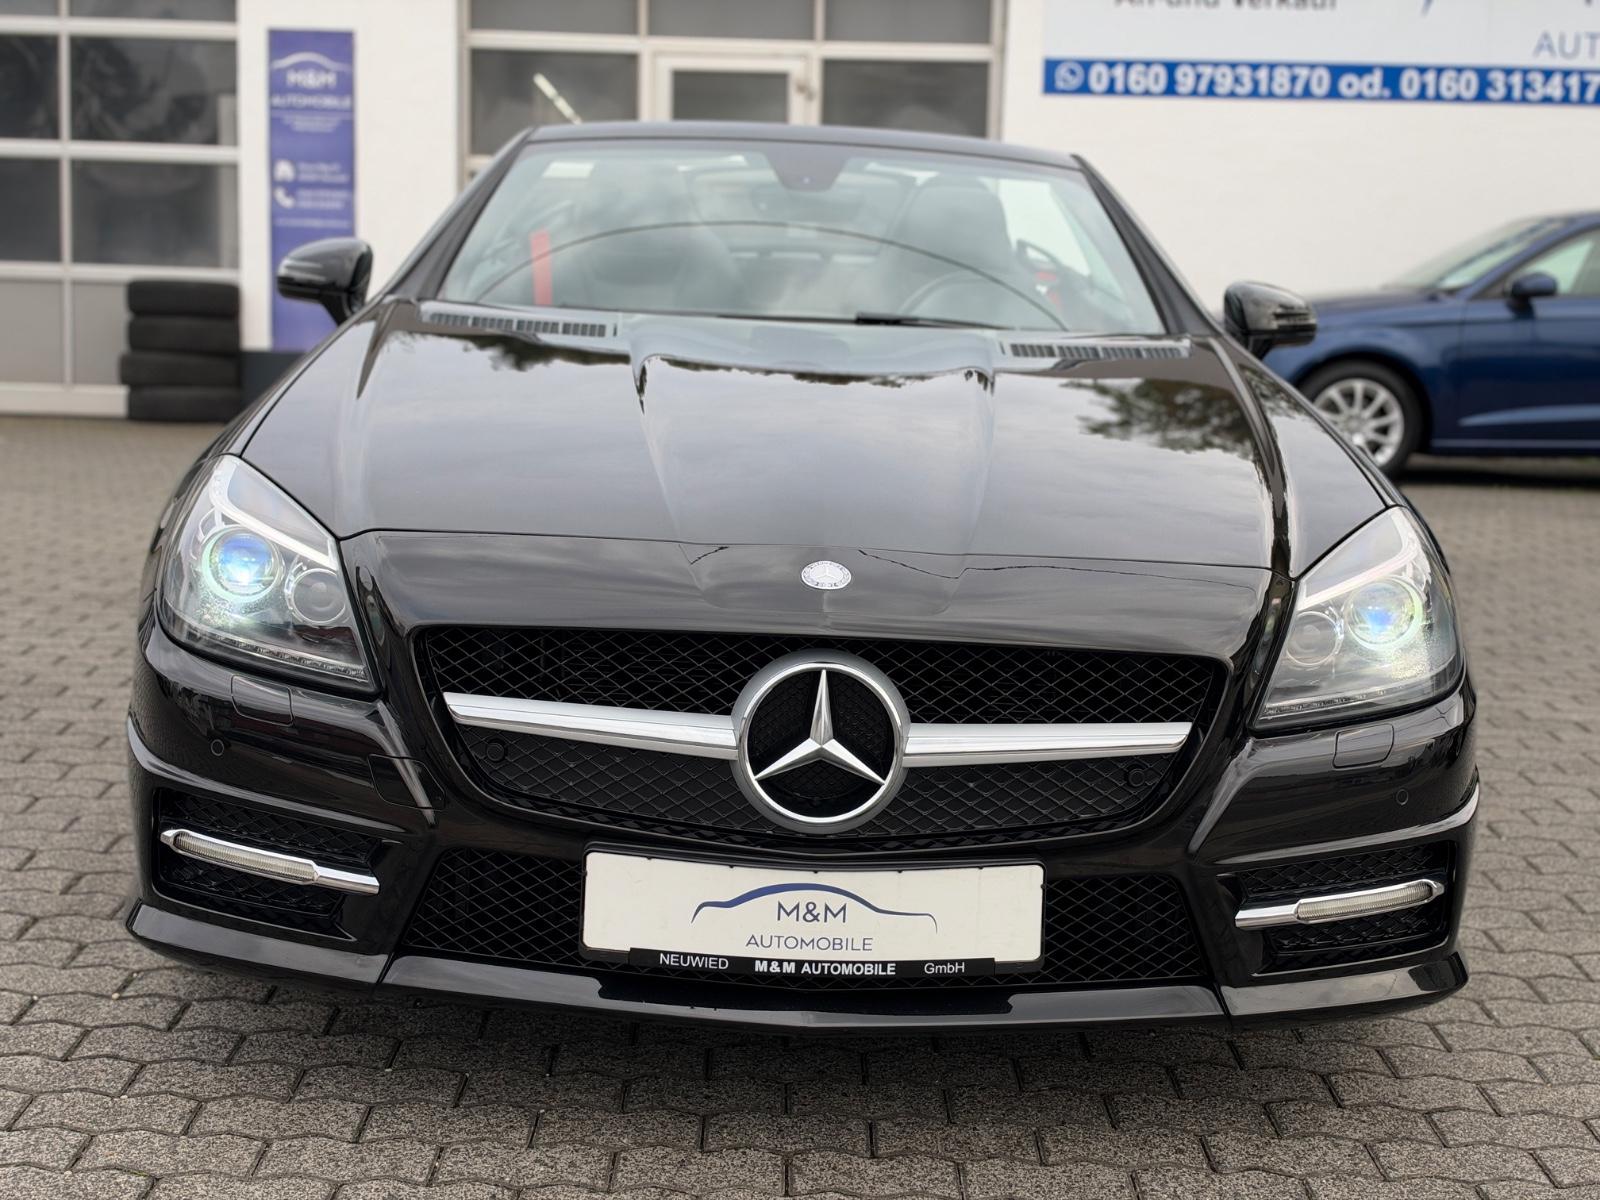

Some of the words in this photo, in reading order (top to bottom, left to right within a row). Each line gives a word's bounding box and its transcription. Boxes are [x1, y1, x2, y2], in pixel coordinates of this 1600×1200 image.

[1088, 62, 1168, 95] 0160
[1174, 64, 1331, 97] 97931870
[1338, 67, 1391, 98] od.
[1400, 68, 1479, 99] 0160
[1486, 69, 1600, 101] 313417
[776, 901, 847, 923] M&M
[745, 934, 873, 951] AUTOMOBILE
[659, 952, 729, 970] NEUWIED
[754, 960, 796, 973] M&M
[801, 962, 897, 976] AUTOMOBILE
[924, 962, 965, 974] GmbH
